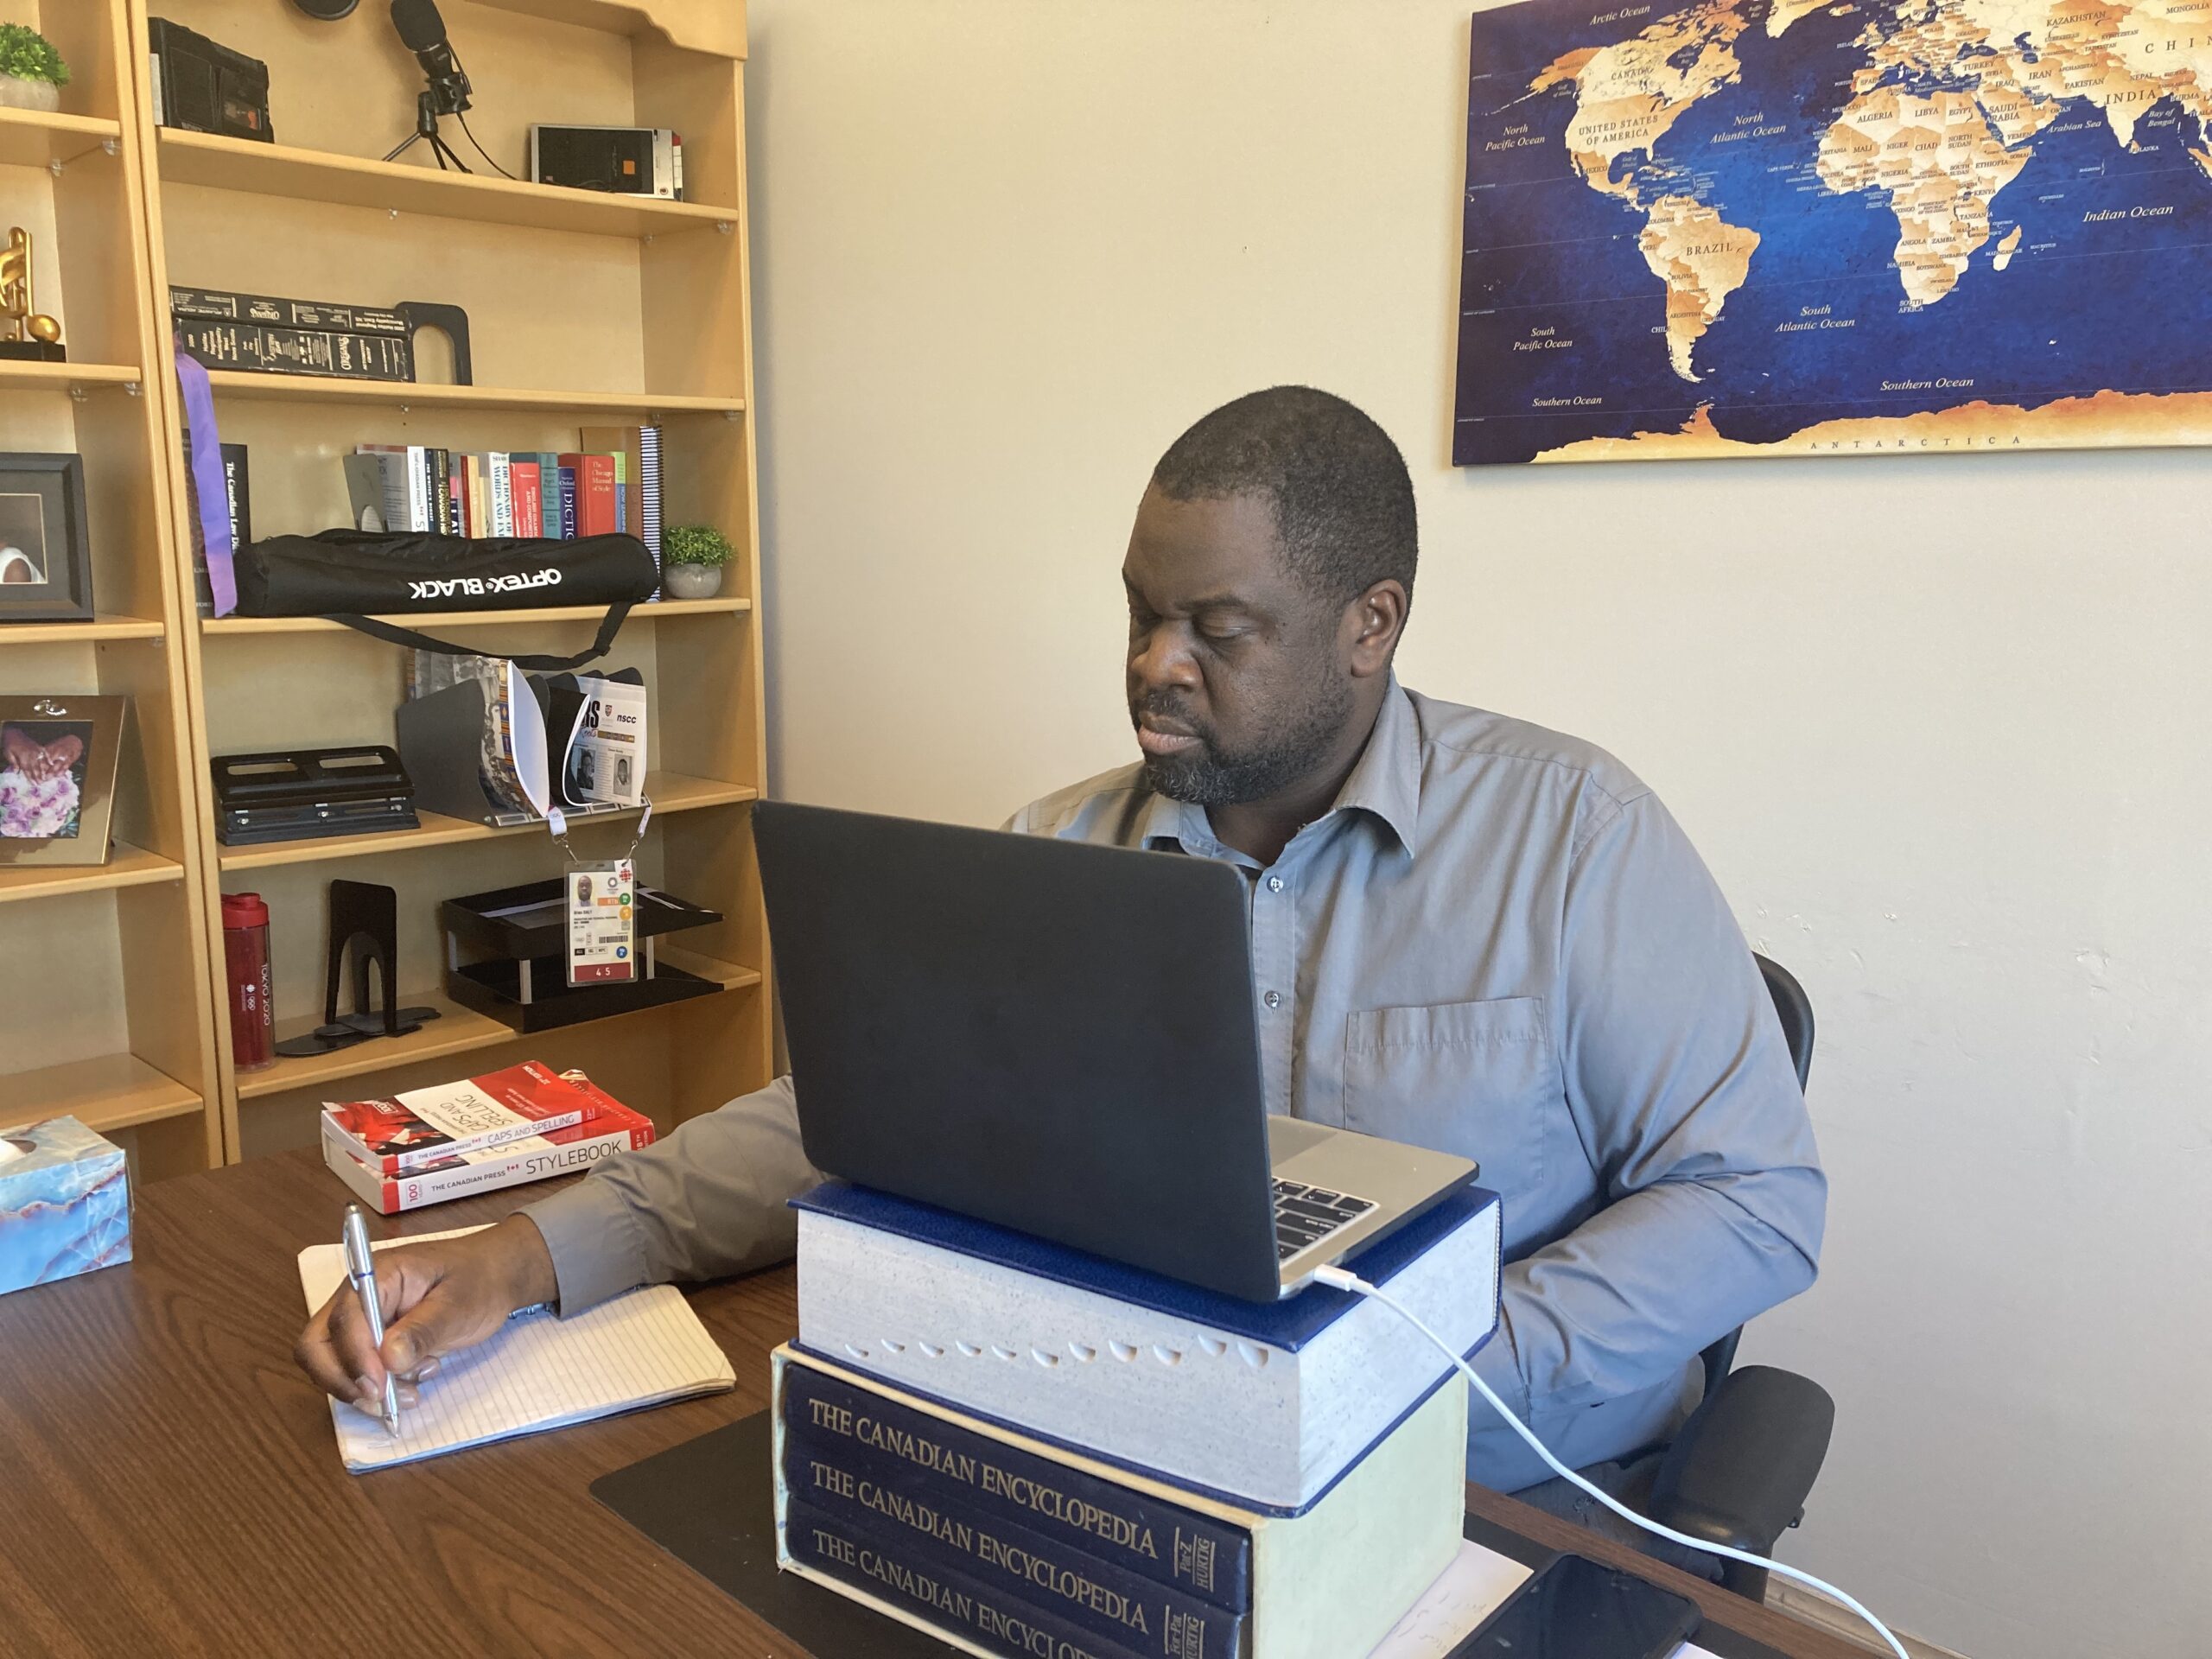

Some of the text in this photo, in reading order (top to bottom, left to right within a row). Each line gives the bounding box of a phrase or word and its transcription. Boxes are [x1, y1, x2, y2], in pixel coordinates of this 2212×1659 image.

[1590, 5, 1650, 25] Arctic Ocean
[2166, 3, 2209, 14] MONGOLIA
[2046, 11, 2106, 27] KAZAKHSTAN
[1963, 60, 1994, 71] TURKEY
[2029, 70, 2052, 80] IRAN
[2130, 73, 2153, 81] NEPAL
[2064, 78, 2104, 89] PAKISTAN
[2106, 90, 2157, 105] INDIA
[1915, 107, 1939, 117] LIBYA
[1948, 107, 1972, 116] EGYPT
[1989, 103, 2018, 113] SAUDI
[2165, 108, 2175, 117] of
[1733, 111, 1764, 126] North
[1858, 111, 1893, 123] ALGERIA
[2147, 118, 2176, 127] Bengal
[1503, 124, 1529, 137] North
[1579, 115, 1658, 136] UNITED STATES
[2047, 123, 2082, 134] Arabian
[1586, 129, 1649, 145] OF AMERICA
[1710, 124, 1786, 144] Atlantic Ocean
[1948, 134, 1972, 143] NORTH
[2007, 131, 2031, 140] YEMEN
[1485, 136, 1545, 151] Pacific Ocean
[1887, 142, 1908, 150] NIGER
[1915, 143, 1937, 151] CHAD
[1975, 159, 2008, 168] ETHIOPIA
[1881, 168, 1908, 177] NIGERIA
[1960, 212, 1993, 220] TANZANIA
[2082, 207, 2174, 222] Indian Ocean
[1686, 243, 1732, 256] BRAZIL
[1800, 304, 1831, 316] South
[1776, 317, 1855, 333] Atlantic Ocean
[1530, 327, 1554, 338] South
[1513, 338, 1573, 352] Pacific Ocean
[1880, 377, 1974, 391] Southern Ocean
[1532, 395, 1602, 407] Southern Ocean
[1810, 436, 2020, 449] ANTARCTICA
[226, 461, 238, 535] The Canadian Law
[493, 467, 505, 519] WORDS AND
[505, 522, 512, 532] OF
[408, 577, 484, 599] BLACK
[617, 715, 636, 723] nscc
[596, 968, 601, 976] 4
[261, 963, 270, 996] TOKYO
[454, 1093, 513, 1126] SPELLING
[439, 1102, 490, 1132] CAPS AND
[487, 1114, 575, 1143] CAPS AND SPELLING
[429, 1147, 454, 1157] CANADIAN
[525, 1140, 624, 1175] STYLEBOOK
[447, 1175, 482, 1188] CANADIAN
[483, 1170, 505, 1180] PRESS
[409, 1184, 418, 1202] 100
[809, 1397, 1160, 1560] THE CANADIAN ENCYCLOPEDIA
[810, 1461, 1149, 1635] THE CANADIAN ENCYCLOPEDIA
[1197, 1537, 1210, 1588] HURTIG
[812, 1528, 855, 1565] THE
[860, 1549, 972, 1622] CANADIAN
[1185, 1616, 1199, 1659] URTIG
